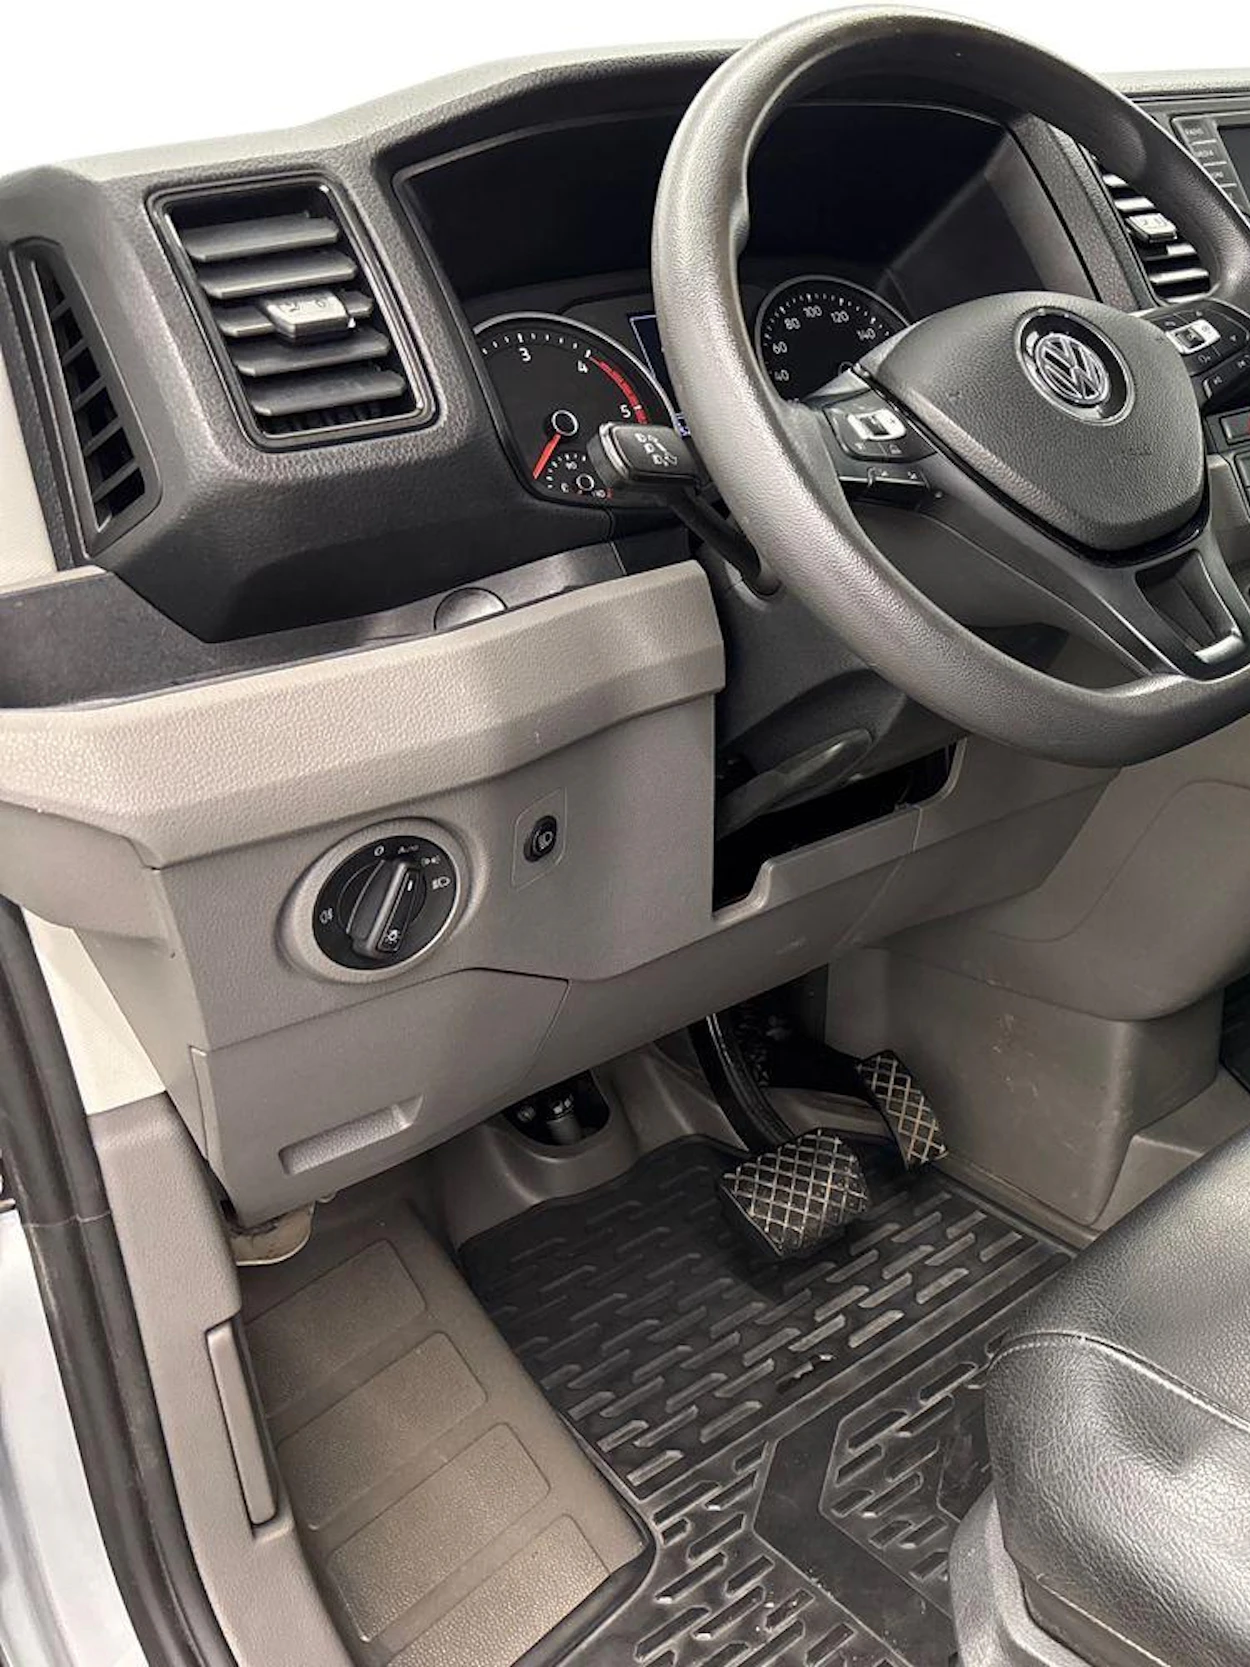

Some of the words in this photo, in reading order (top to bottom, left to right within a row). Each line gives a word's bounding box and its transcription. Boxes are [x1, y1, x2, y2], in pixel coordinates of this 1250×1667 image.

[803, 305, 823, 318] 100
[830, 310, 850, 323] 120
[784, 317, 801, 330] 80
[856, 327, 877, 341] 140
[772, 341, 788, 354] 60
[518, 347, 532, 362] 3
[577, 360, 589, 374] 4
[1036, 333, 1109, 403] VW
[774, 369, 790, 382] 40
[619, 403, 632, 418] 5
